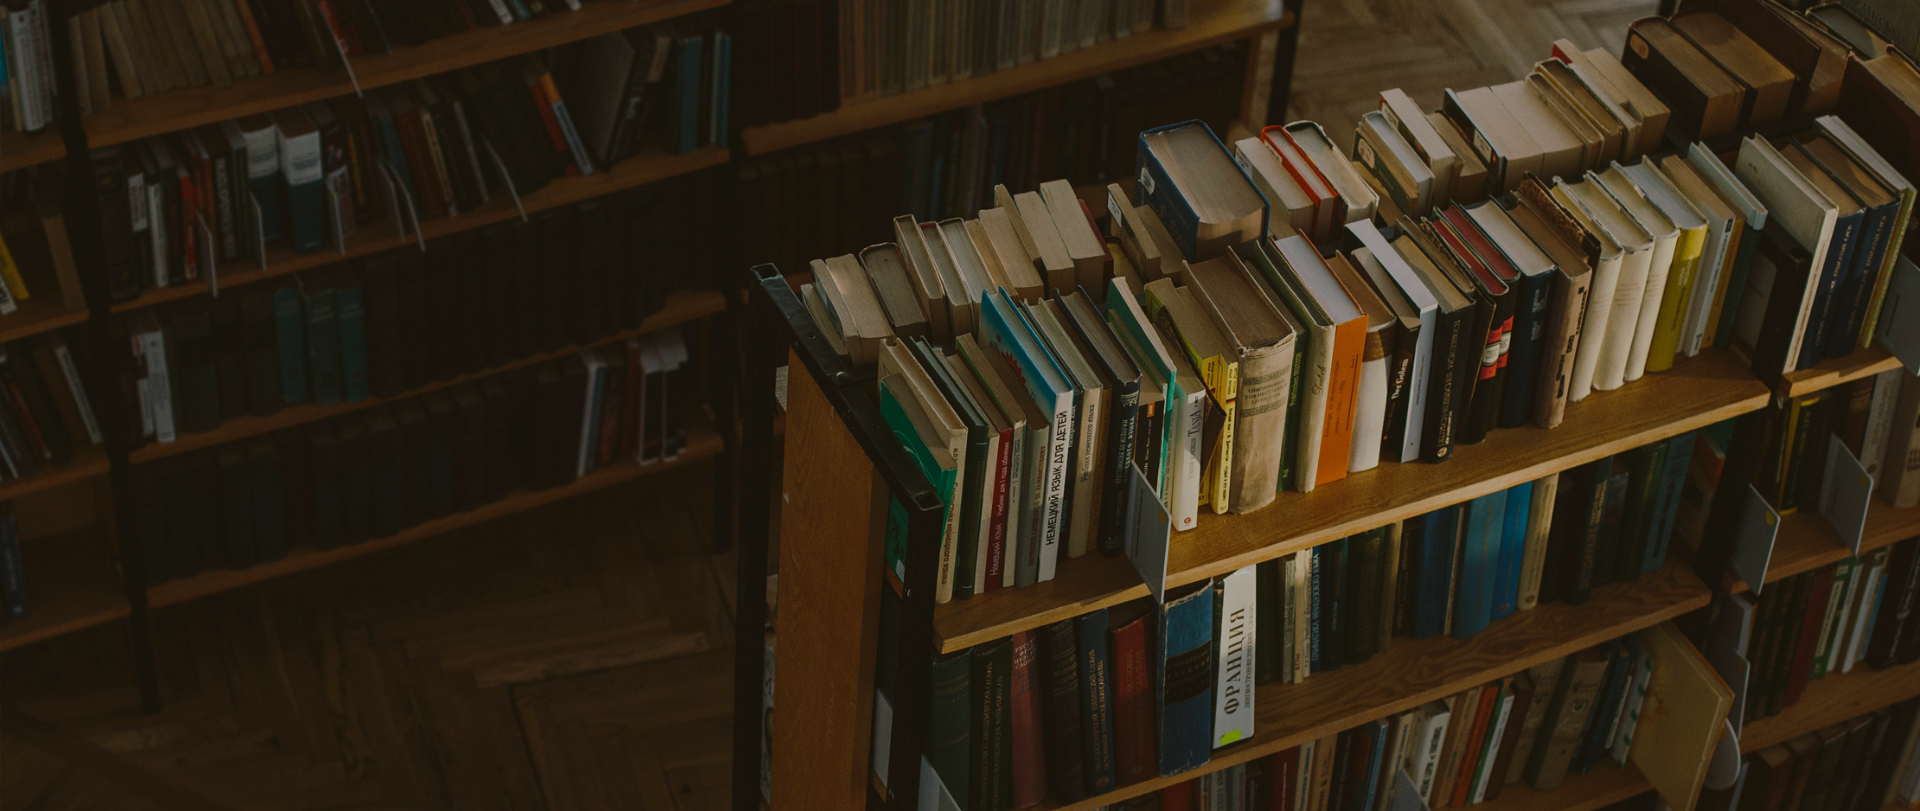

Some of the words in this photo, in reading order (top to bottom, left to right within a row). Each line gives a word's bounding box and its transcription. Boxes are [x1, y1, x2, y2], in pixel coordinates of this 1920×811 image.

[1394, 356, 1410, 385] Golem
[1390, 383, 1402, 400] Der
[1053, 409, 1068, 441] ДЕТЕЙ
[1187, 408, 1202, 437] TANJA
[1000, 441, 1010, 465] обучения
[1053, 442, 1064, 463] ДЛЯ
[1081, 423, 1095, 455] немецкого
[1119, 443, 1125, 451] ПО
[1051, 464, 1063, 492] ЯЗЫК
[1115, 451, 1124, 483] ХРЕСТОМАТИЯ
[1281, 467, 1291, 479] 2
[995, 494, 1005, 517] Учебник
[1043, 493, 1061, 546] НЕМЕЦКИЙ
[942, 523, 953, 562] немецкого
[992, 522, 1004, 540] язык
[987, 540, 1003, 576] Немецкий
[940, 563, 949, 585] языка
[1310, 574, 1321, 619] ФРАНЦУЗСКОГО
[1309, 619, 1321, 661] ГРАММАТИКА
[1125, 649, 1133, 680] СЛОВАРЬ
[1219, 606, 1249, 715] ФРАНЦИЯ
